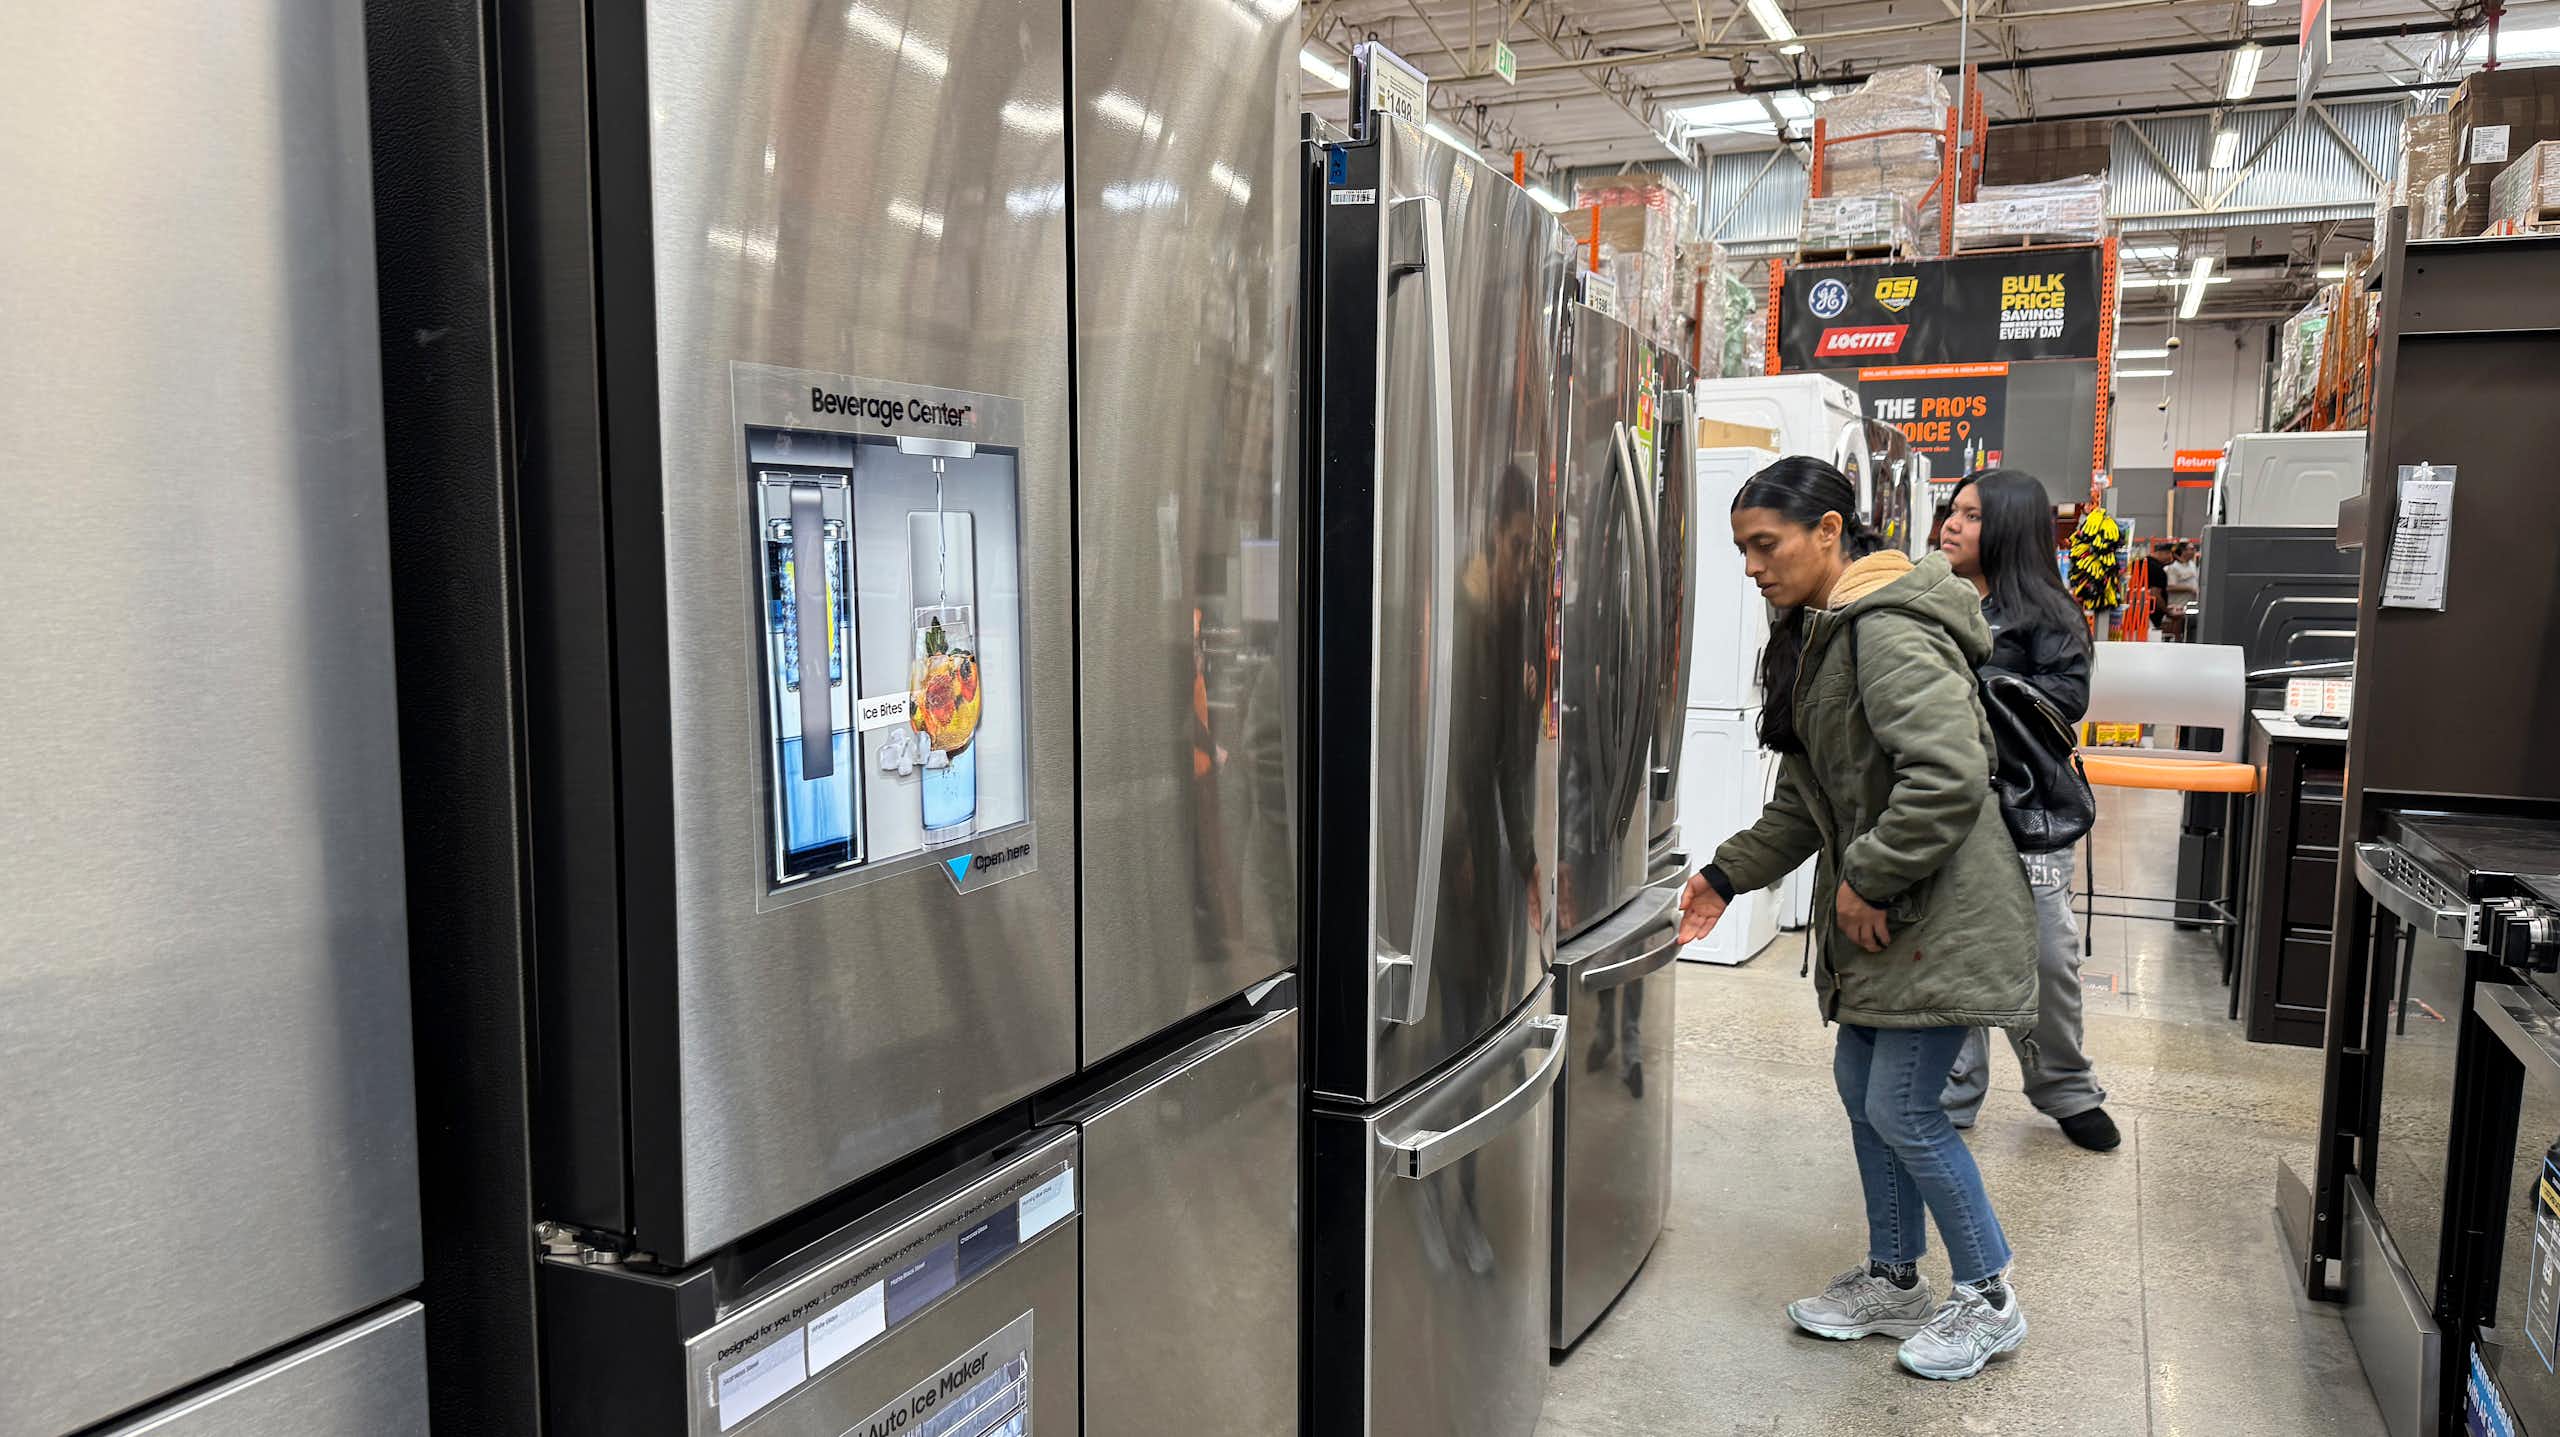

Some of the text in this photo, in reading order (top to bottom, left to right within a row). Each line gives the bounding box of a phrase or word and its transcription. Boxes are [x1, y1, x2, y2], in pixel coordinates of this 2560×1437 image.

[1500, 46, 1514, 78] EXIT
[1875, 278, 1919, 300] OSI
[2002, 273, 2065, 294] BULK
[2001, 292, 2066, 310] PRICE
[2001, 308, 2065, 321] SAVINGS
[1826, 332, 1897, 350] LOCTITE
[2000, 325, 2063, 340] EVERY DAY
[811, 387, 904, 428] Beverage
[1874, 396, 1988, 420] THE PRO'S
[863, 708, 878, 720] Ice
[975, 843, 1031, 873] Open here
[718, 1327, 759, 1362] Designed
[760, 1321, 773, 1338] for
[792, 1305, 804, 1323] by
[804, 1298, 820, 1316] you
[868, 1352, 988, 1437] Auto Ice Maker
